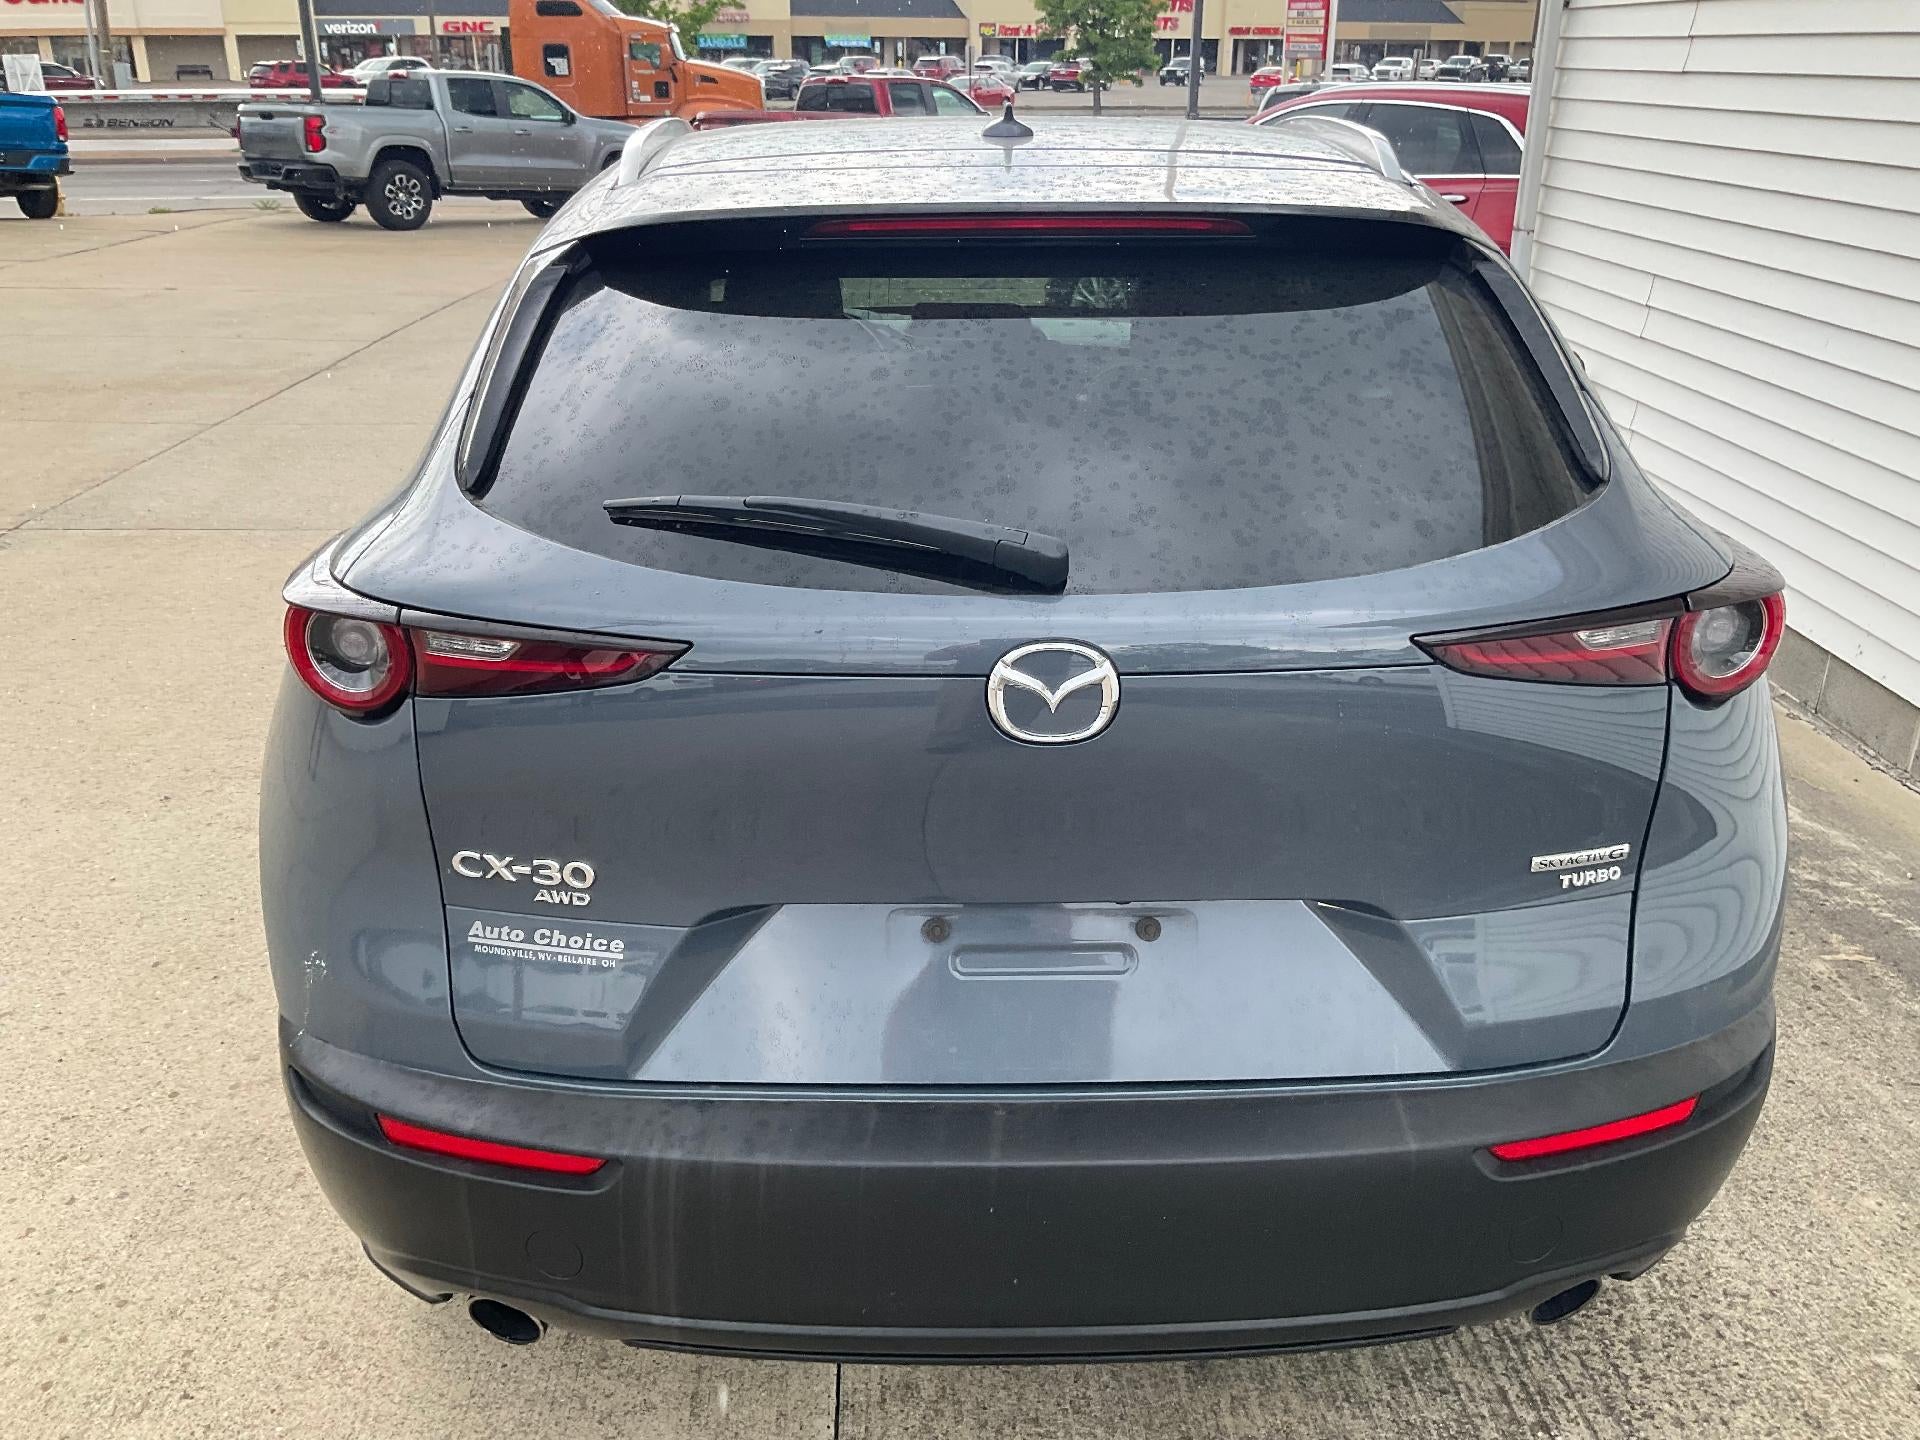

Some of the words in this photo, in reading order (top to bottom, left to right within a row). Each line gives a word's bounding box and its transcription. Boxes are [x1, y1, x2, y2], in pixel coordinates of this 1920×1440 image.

[324, 20, 377, 34] verizon
[443, 21, 495, 33] GNC
[451, 849, 597, 890] CX-30
[1559, 866, 1622, 889] TURBO
[533, 889, 592, 906] AWD
[467, 920, 525, 942] Auto
[533, 928, 625, 953] Choice
[474, 944, 537, 961] MOUNDSVILLE,
[557, 954, 597, 966] BELLAIRE
[601, 959, 616, 968] OH
